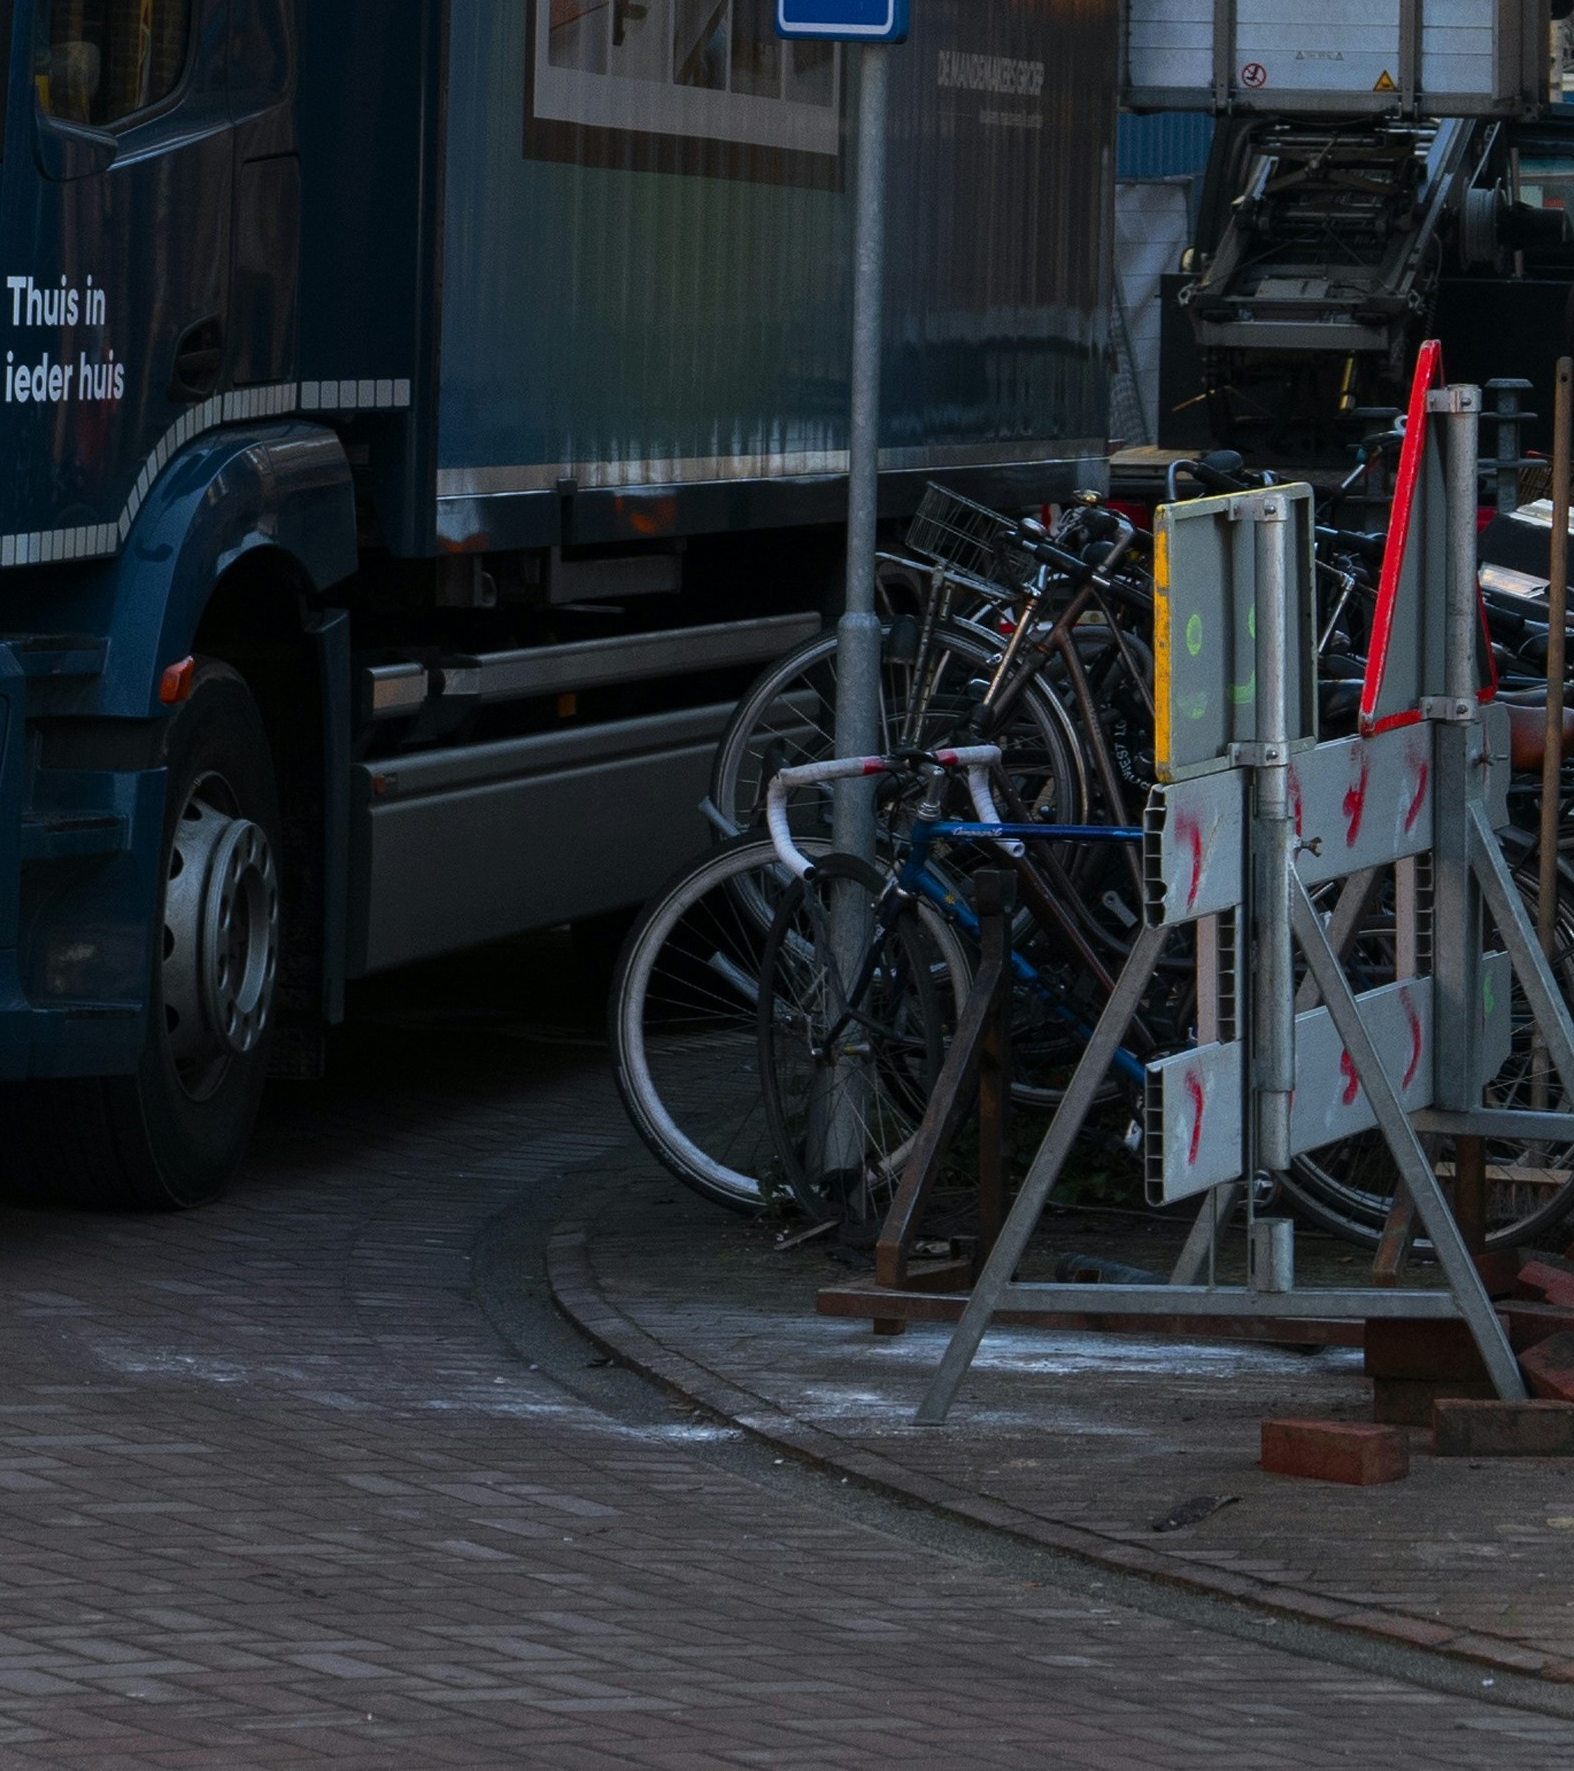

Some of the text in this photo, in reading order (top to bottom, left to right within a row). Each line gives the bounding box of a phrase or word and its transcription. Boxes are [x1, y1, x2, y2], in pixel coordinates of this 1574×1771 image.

[6, 275, 106, 327] Thuis in
[5, 351, 125, 404] ieder huis
